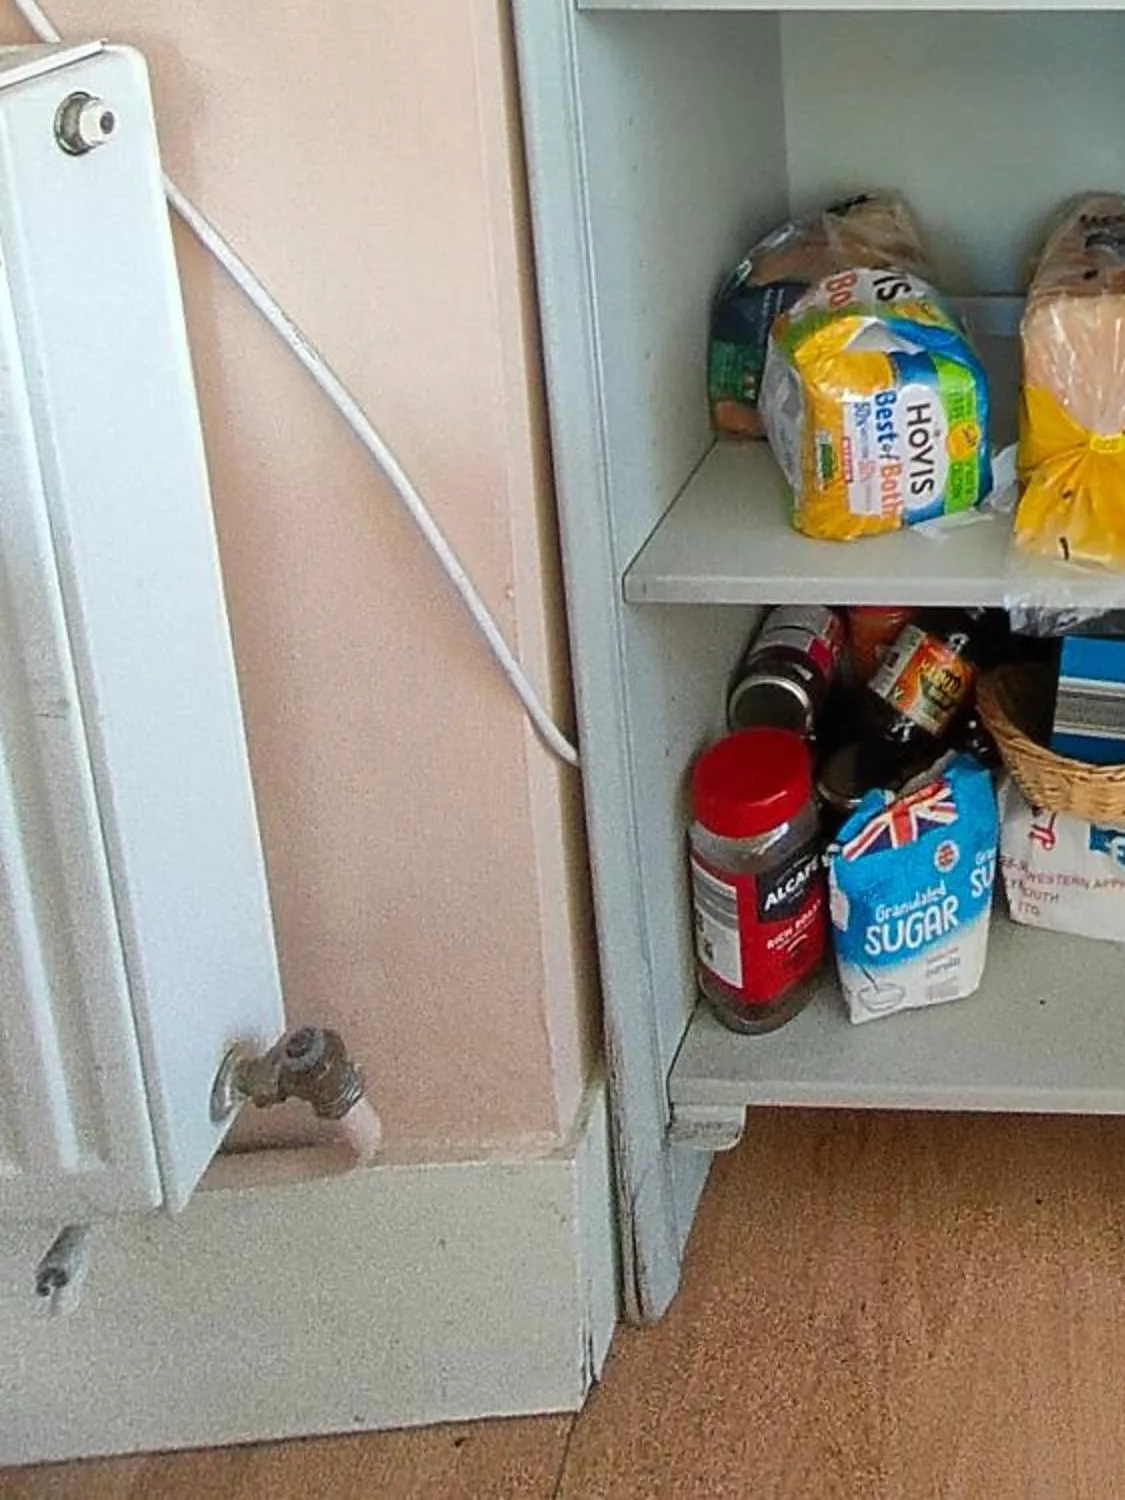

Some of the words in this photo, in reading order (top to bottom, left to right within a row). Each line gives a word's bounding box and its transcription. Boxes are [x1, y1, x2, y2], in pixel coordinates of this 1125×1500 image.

[874, 390, 898, 443] Best
[906, 402, 935, 496] HOVIS
[864, 895, 961, 956] SUGAR
[875, 879, 947, 923] Granulated
